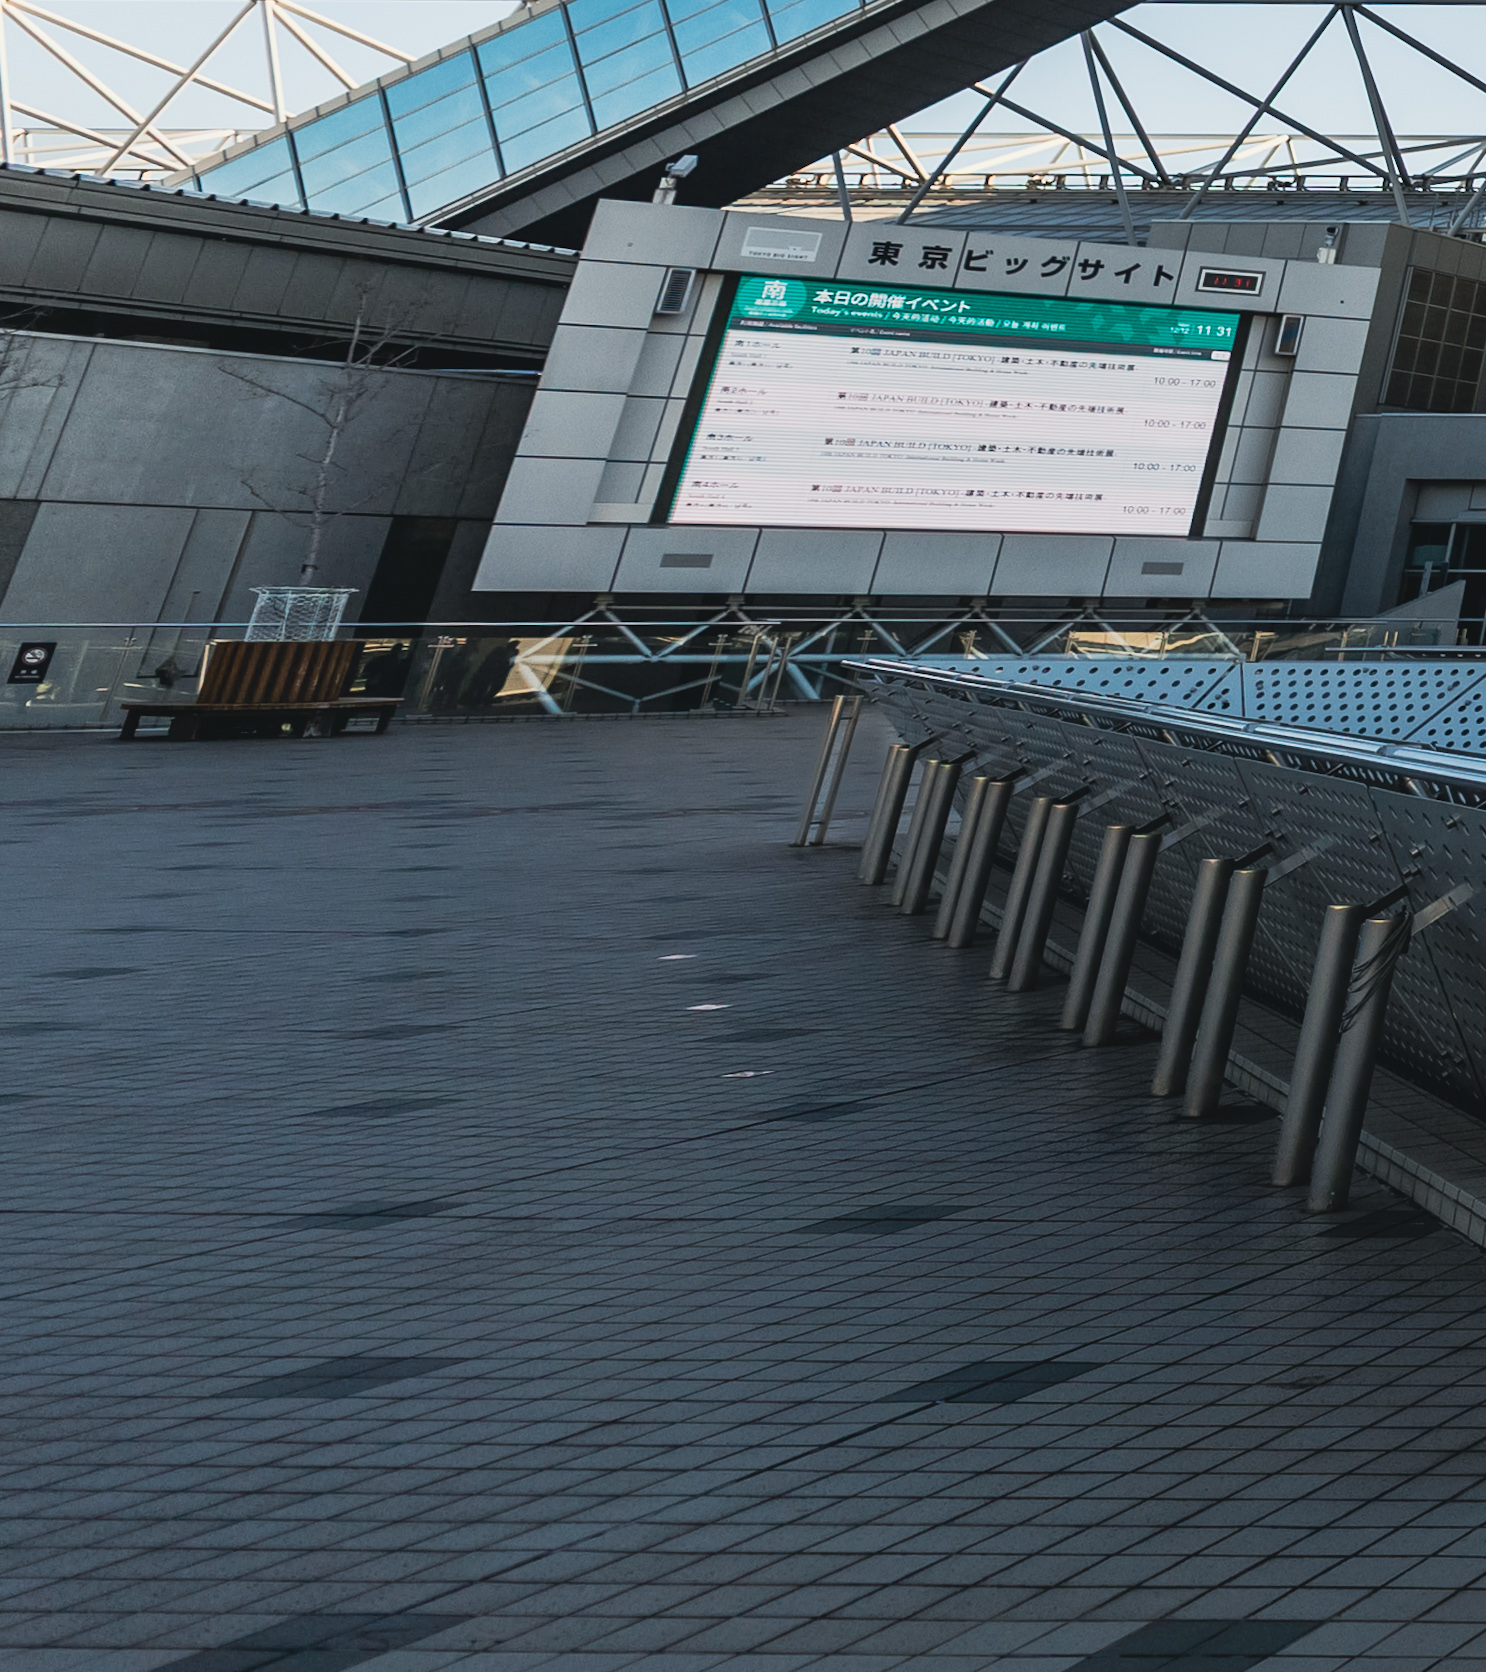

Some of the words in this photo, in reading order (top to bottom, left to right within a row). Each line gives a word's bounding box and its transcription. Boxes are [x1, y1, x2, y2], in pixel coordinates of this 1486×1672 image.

[868, 240, 1175, 287] 東京ビッグサイト
[762, 280, 788, 300] 南
[813, 289, 971, 313] 本日の開催イベント
[811, 306, 849, 317] Today's
[851, 310, 882, 318] events
[883, 348, 917, 358] JAPAN
[919, 350, 951, 360] BUILD
[870, 393, 904, 403] JAPAN
[907, 395, 938, 405] BUILD
[858, 439, 892, 449] JAPAN
[894, 440, 926, 449] BUILD
[845, 485, 879, 494] JAPAN
[881, 486, 914, 495] BUILD
